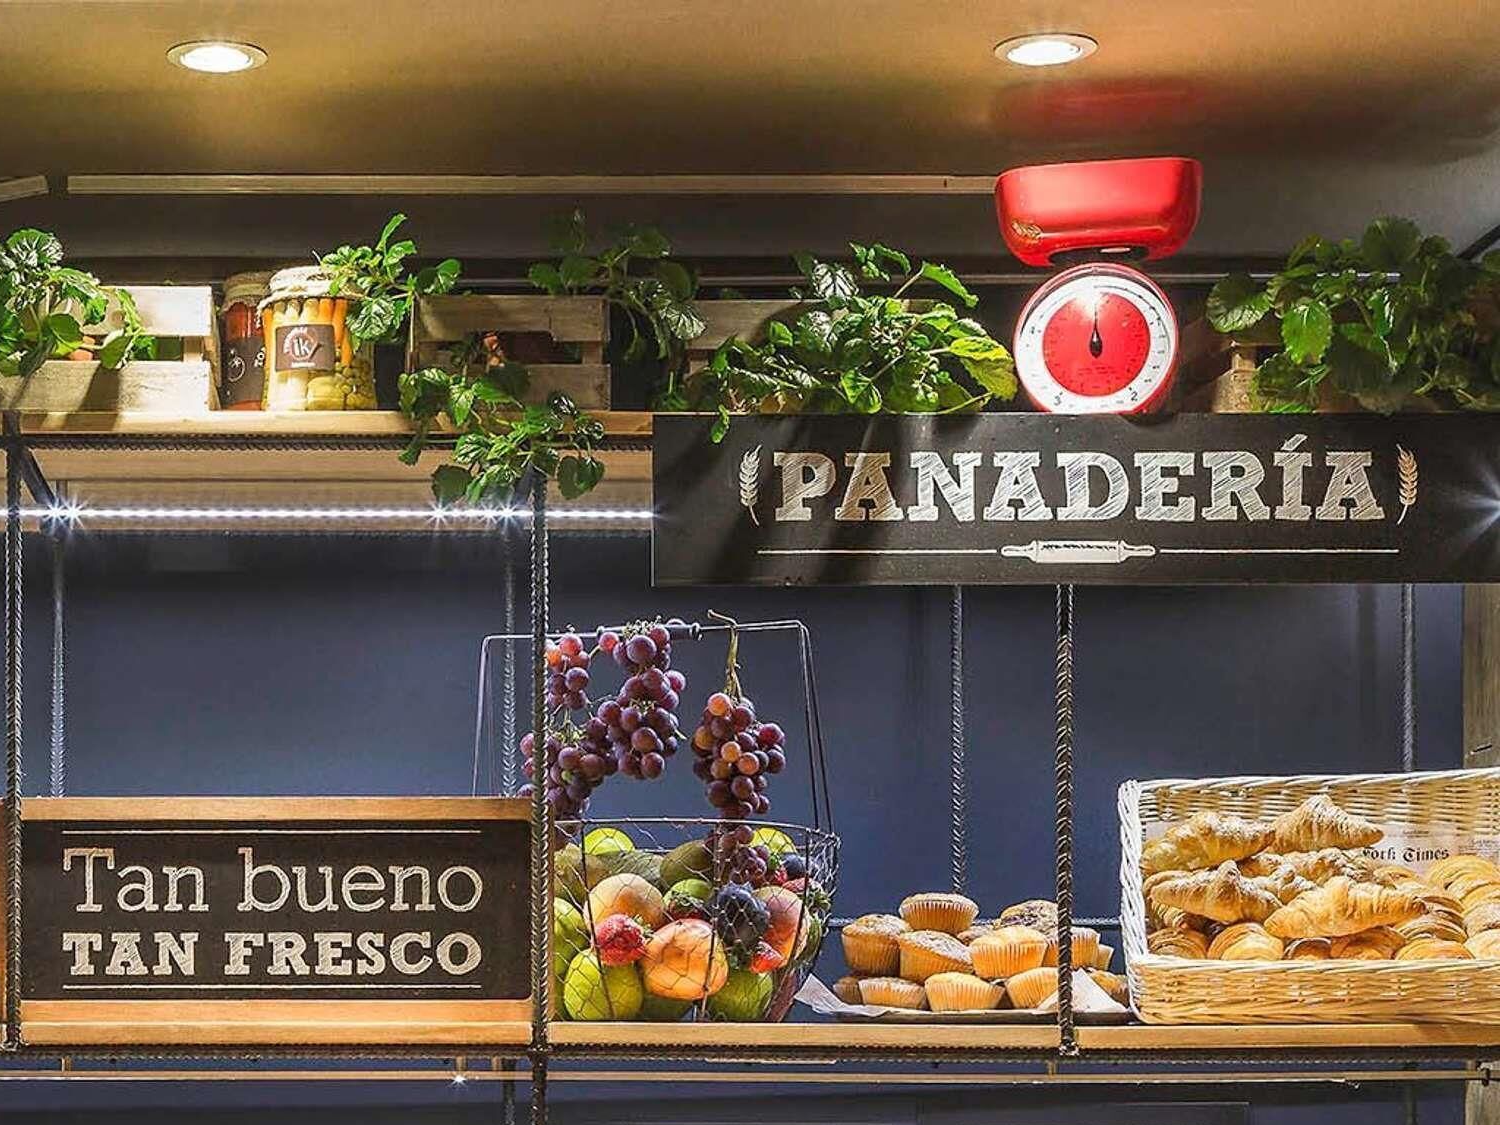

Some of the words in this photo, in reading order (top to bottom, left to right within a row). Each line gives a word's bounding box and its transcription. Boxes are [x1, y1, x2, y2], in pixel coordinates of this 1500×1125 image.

[774, 434, 1386, 523] PANADERÍA
[62, 846, 209, 913] Tan
[237, 846, 483, 913] bueno
[1402, 847, 1450, 862] Times
[62, 931, 199, 976] TAN
[223, 931, 482, 976] FRESCO
